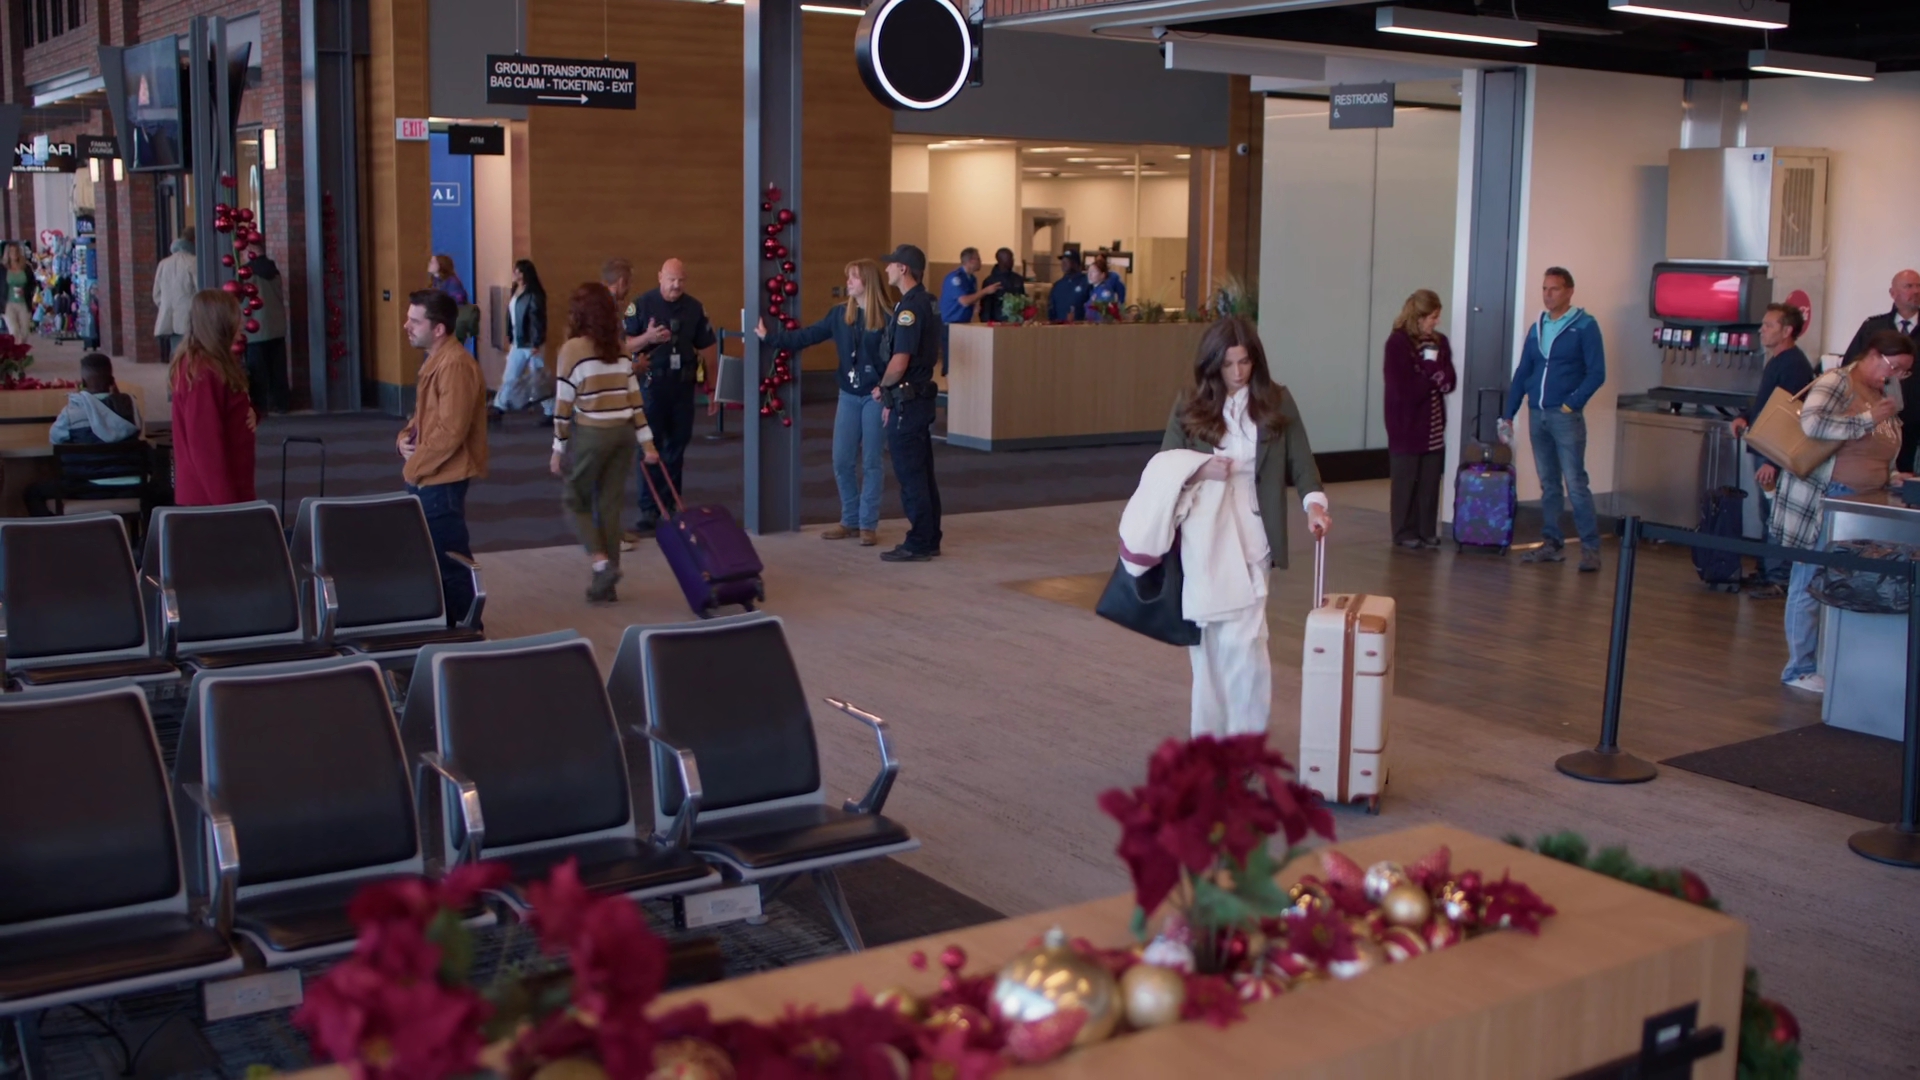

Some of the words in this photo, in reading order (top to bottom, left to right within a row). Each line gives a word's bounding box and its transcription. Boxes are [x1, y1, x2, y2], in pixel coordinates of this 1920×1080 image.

[495, 62, 540, 75] GROUND
[541, 64, 629, 80] TRANSPORTATION
[490, 76, 512, 88] BAG
[513, 77, 545, 89] CLAIM
[552, 78, 605, 92] TICKETING
[612, 81, 634, 93] EXIT
[1334, 92, 1388, 105] RESTROOMS
[402, 121, 423, 137] EXIT
[469, 136, 485, 144] ATM
[14, 142, 72, 156] NAR
